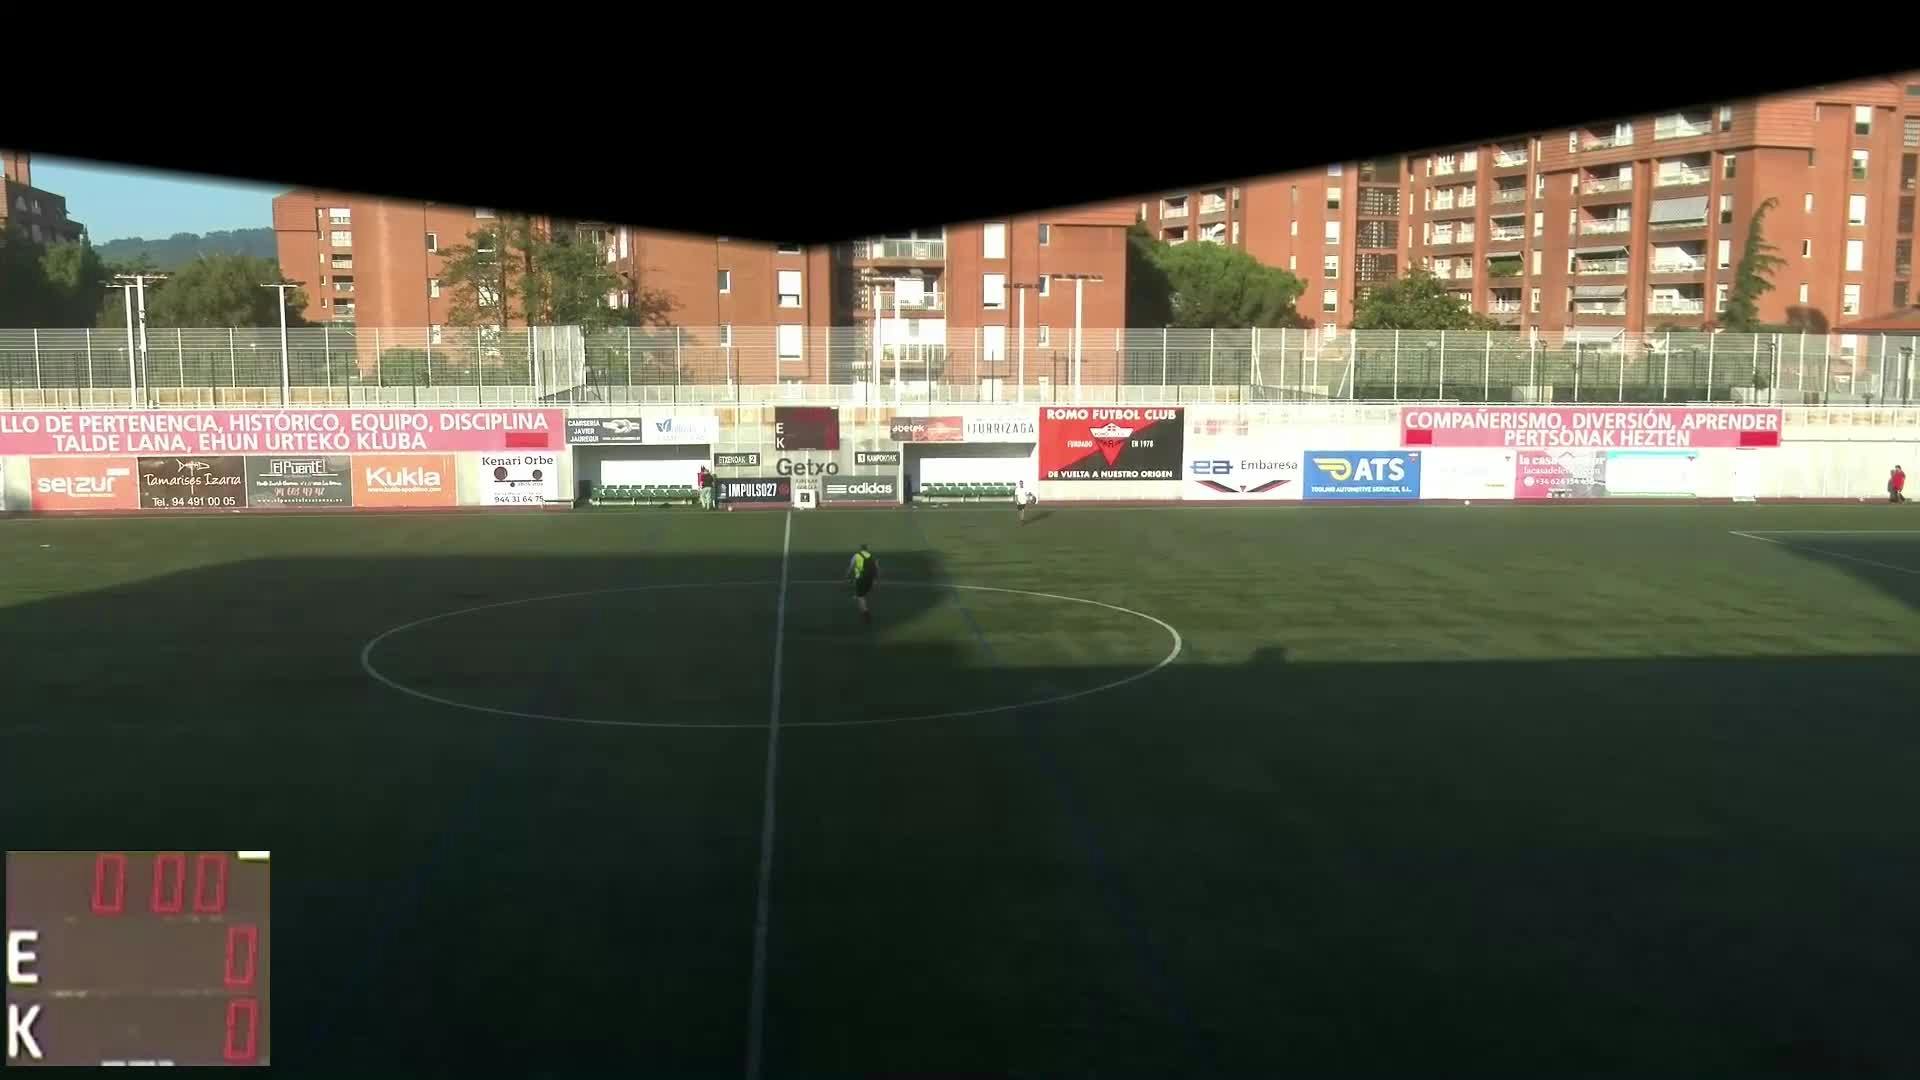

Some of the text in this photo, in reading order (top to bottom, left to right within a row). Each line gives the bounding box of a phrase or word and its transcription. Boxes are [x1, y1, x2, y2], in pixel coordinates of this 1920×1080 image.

[1047, 409, 1177, 420] ROMO FUTBOL CLUB
[1405, 409, 1778, 432] COMPAÑERISMO, DIVERSIÓN, APRENDER
[45, 415, 74, 434] DE
[79, 414, 223, 434] PERTENENCIA,
[230, 410, 345, 433] HISTÓRICO,
[351, 412, 434, 433] EQUIPO,
[440, 412, 549, 431] DISCIPLINA
[775, 422, 785, 435] E
[53, 432, 427, 453] TALDE LANA, EHUN URTEKO KLUBA
[775, 437, 785, 449] K
[1504, 429, 1691, 448] PERTSONAK HEZTEN
[482, 455, 554, 466] Kenari Orbe
[776, 458, 839, 476] Getxo
[1240, 459, 1299, 471] Embaresa
[1048, 470, 1173, 478] DE VUELTA A NUESTRO ORIGEN
[1353, 457, 1405, 481] ATS
[204, 473, 242, 486] Izarra
[366, 466, 441, 487] Kukla
[848, 482, 893, 494] adidas
[151, 497, 236, 507] Tel. 94 491 00 05
